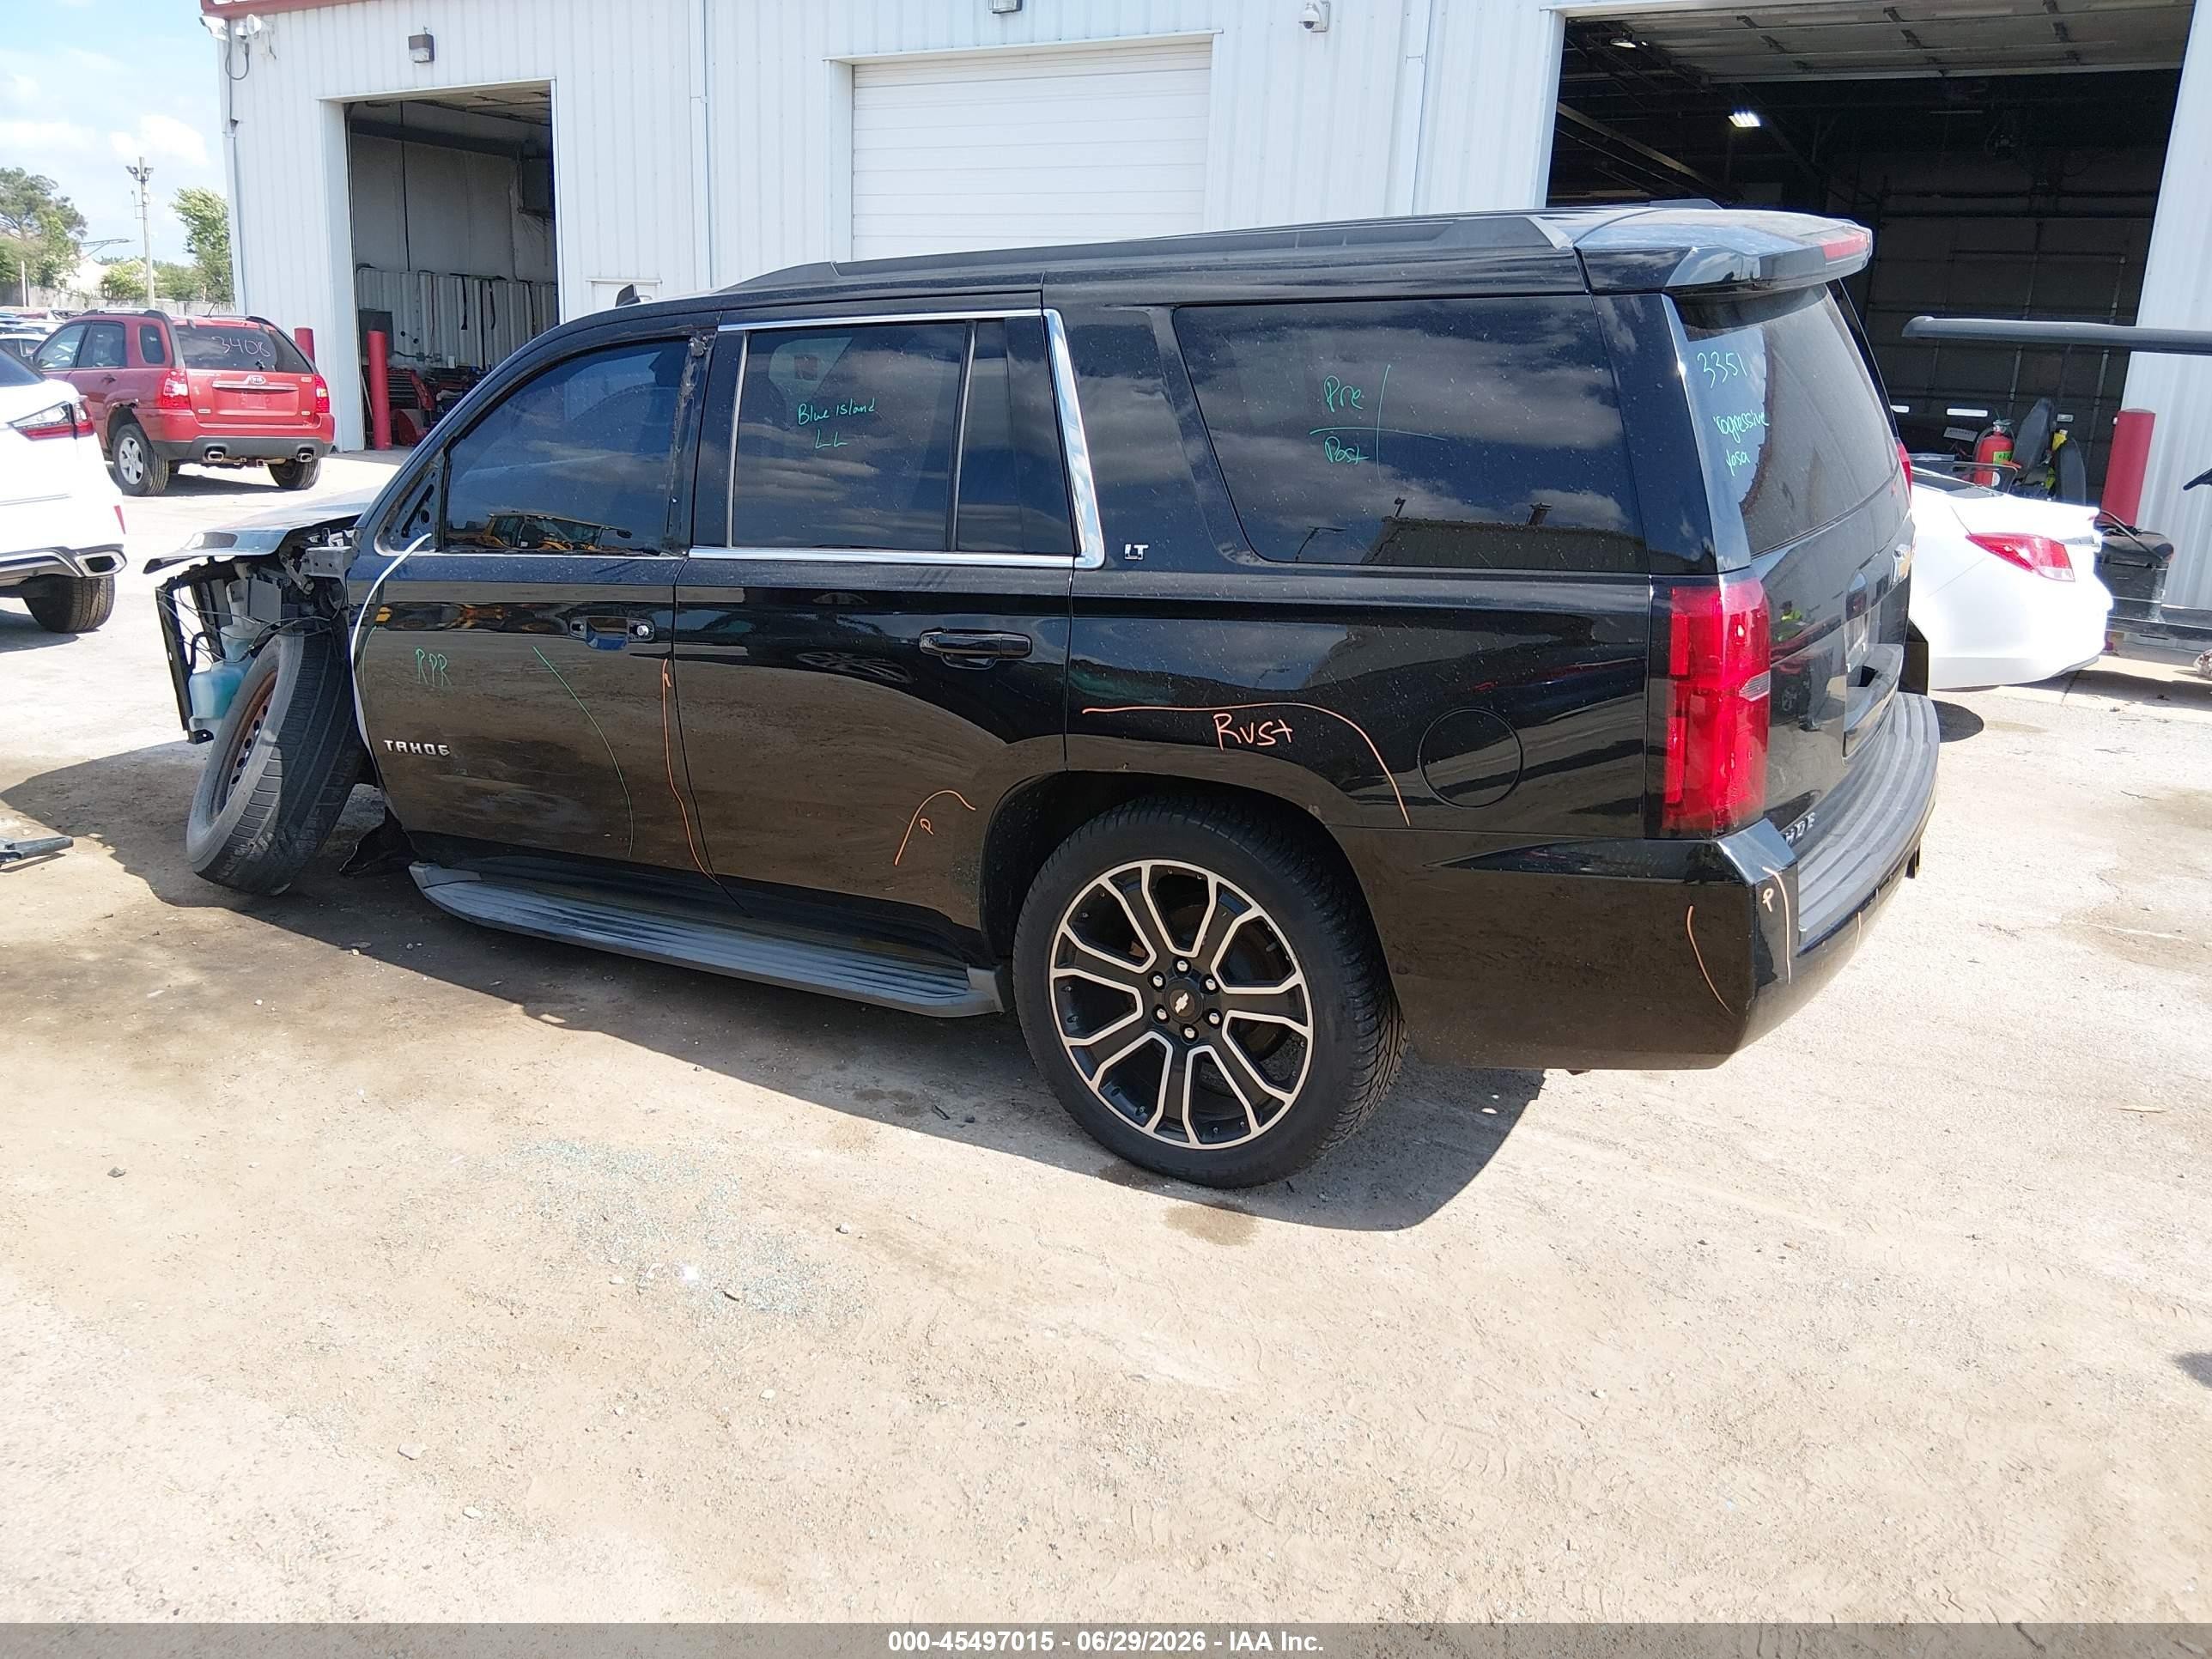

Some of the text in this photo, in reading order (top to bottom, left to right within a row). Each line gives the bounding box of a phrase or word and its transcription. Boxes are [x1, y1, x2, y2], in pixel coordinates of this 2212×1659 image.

[1697, 351, 1747, 389] 3351
[1323, 375, 1364, 413] Pre
[798, 403, 830, 425] Blue
[1713, 409, 1770, 444] rogressive
[1324, 435, 1370, 465] Post
[1124, 544, 1149, 560] LT
[384, 739, 451, 757] TAHOE
